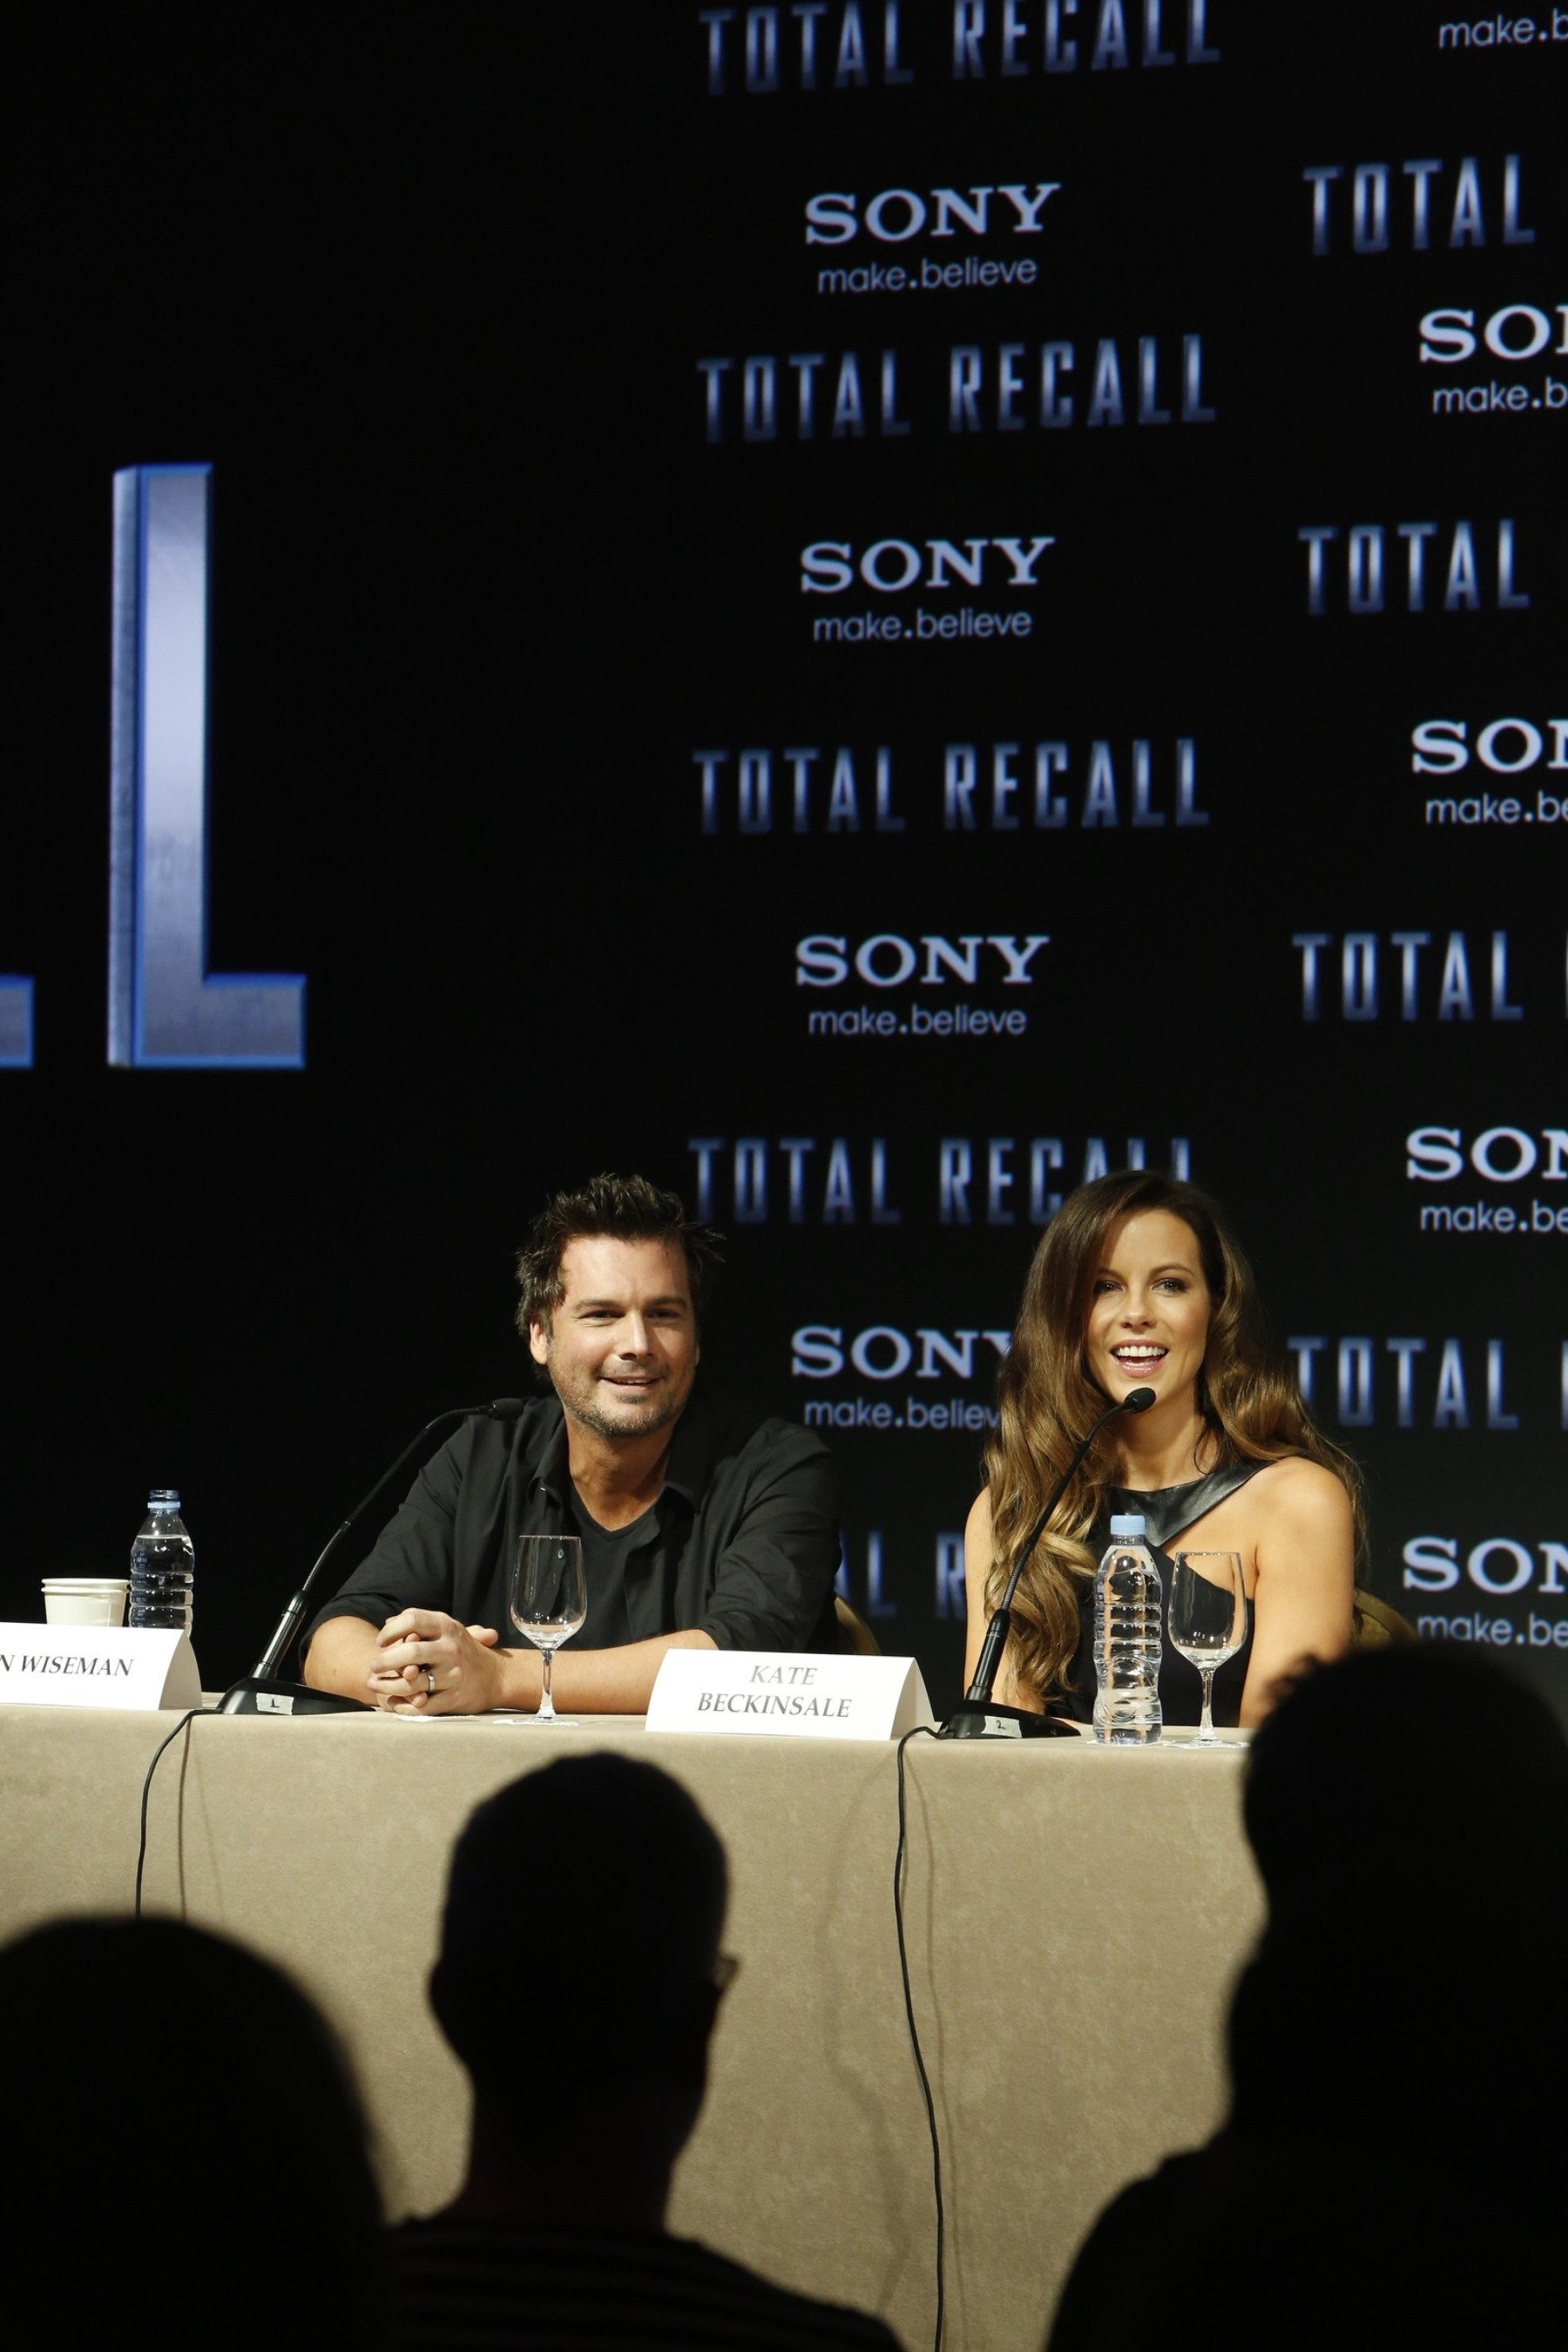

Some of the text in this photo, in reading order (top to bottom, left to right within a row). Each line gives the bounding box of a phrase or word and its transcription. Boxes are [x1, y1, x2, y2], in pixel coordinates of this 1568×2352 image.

[700, 0, 1220, 93] TOTAL RECALL
[804, 181, 1063, 246] SONY
[1302, 152, 1536, 254] TOTAL
[818, 256, 1038, 294] make.believe
[1419, 302, 1568, 364] SO
[697, 333, 1216, 442] TOTAL RECALL
[800, 535, 1057, 594] SONY
[1298, 517, 1531, 615] TOTAL
[814, 607, 1034, 642] make.believe
[693, 737, 1210, 834] TOTAL RECALL
[795, 933, 1051, 988] SONY
[1292, 929, 1524, 1022] TOTAL
[808, 1003, 1029, 1037] make.believe
[688, 1138, 900, 1223] TOTAL
[803, 1396, 1000, 1430] make.believ
[1288, 1335, 1519, 1429] TOTAL
[22, 1655, 134, 1676] WISEMAN
[749, 1665, 818, 1685] KATE
[697, 1693, 852, 1718] BECKINSALE
